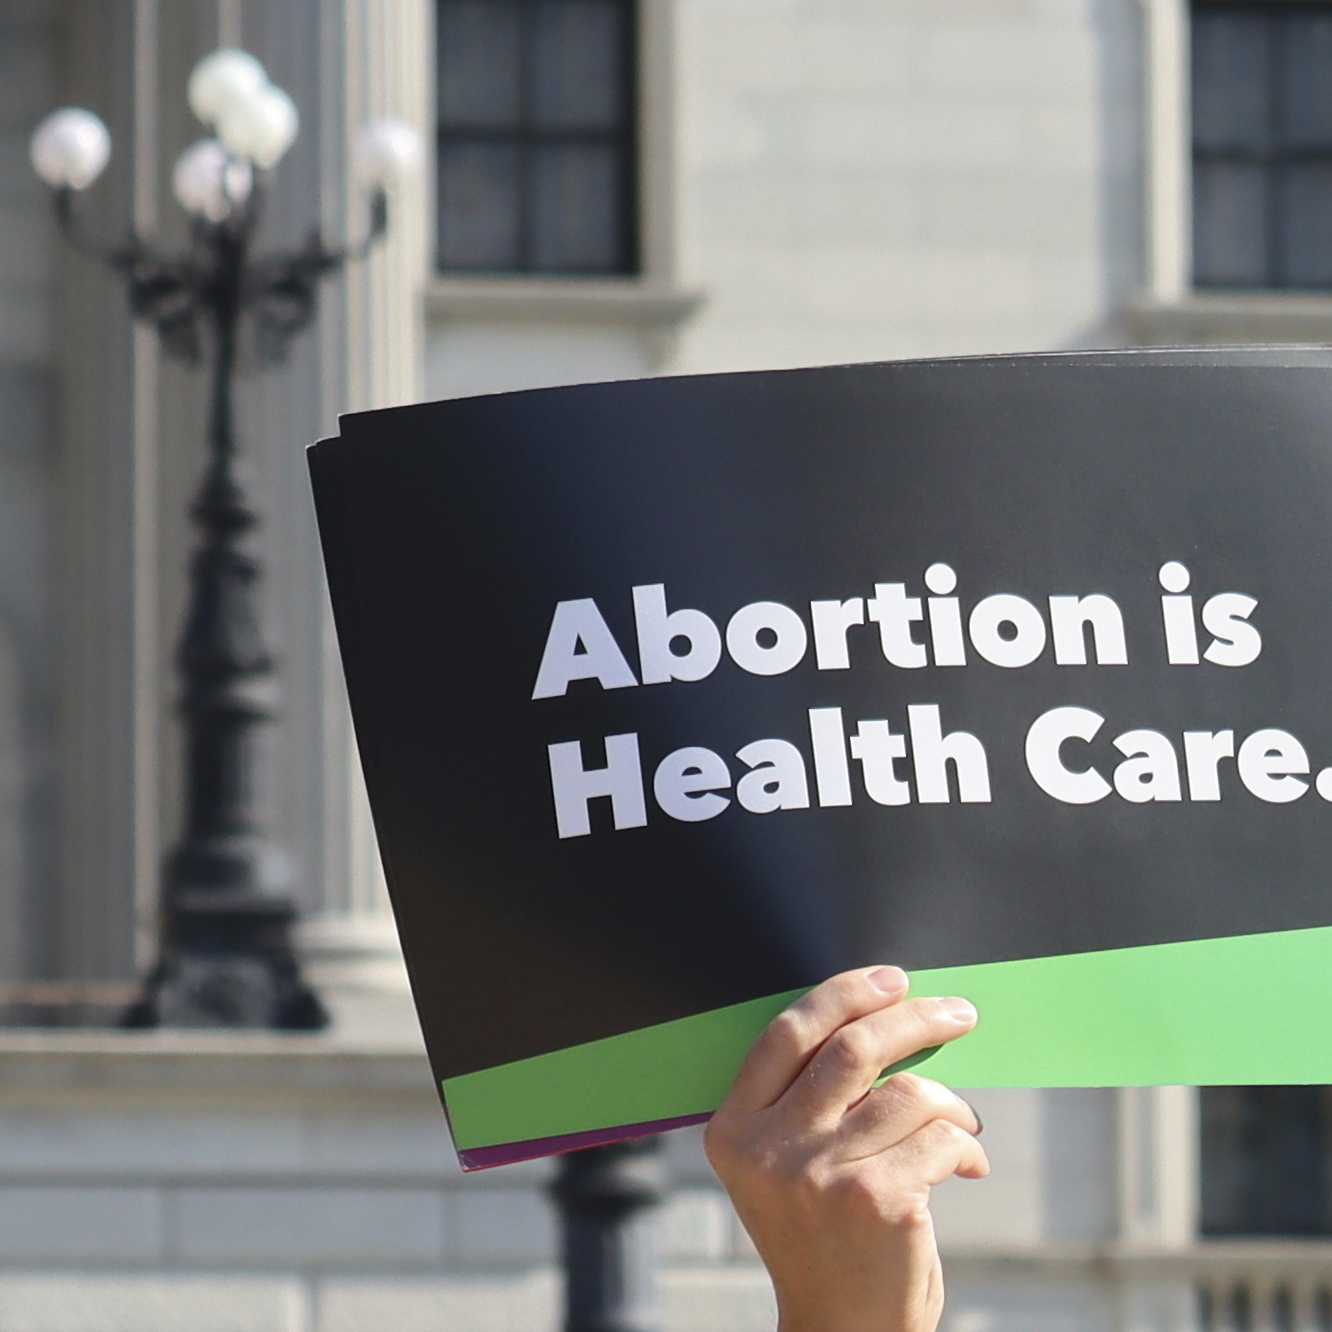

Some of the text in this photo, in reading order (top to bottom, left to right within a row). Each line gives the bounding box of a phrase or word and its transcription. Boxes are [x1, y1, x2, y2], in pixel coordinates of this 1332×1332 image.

[531, 560, 1264, 700] Abortion is
[547, 702, 992, 839] Health
